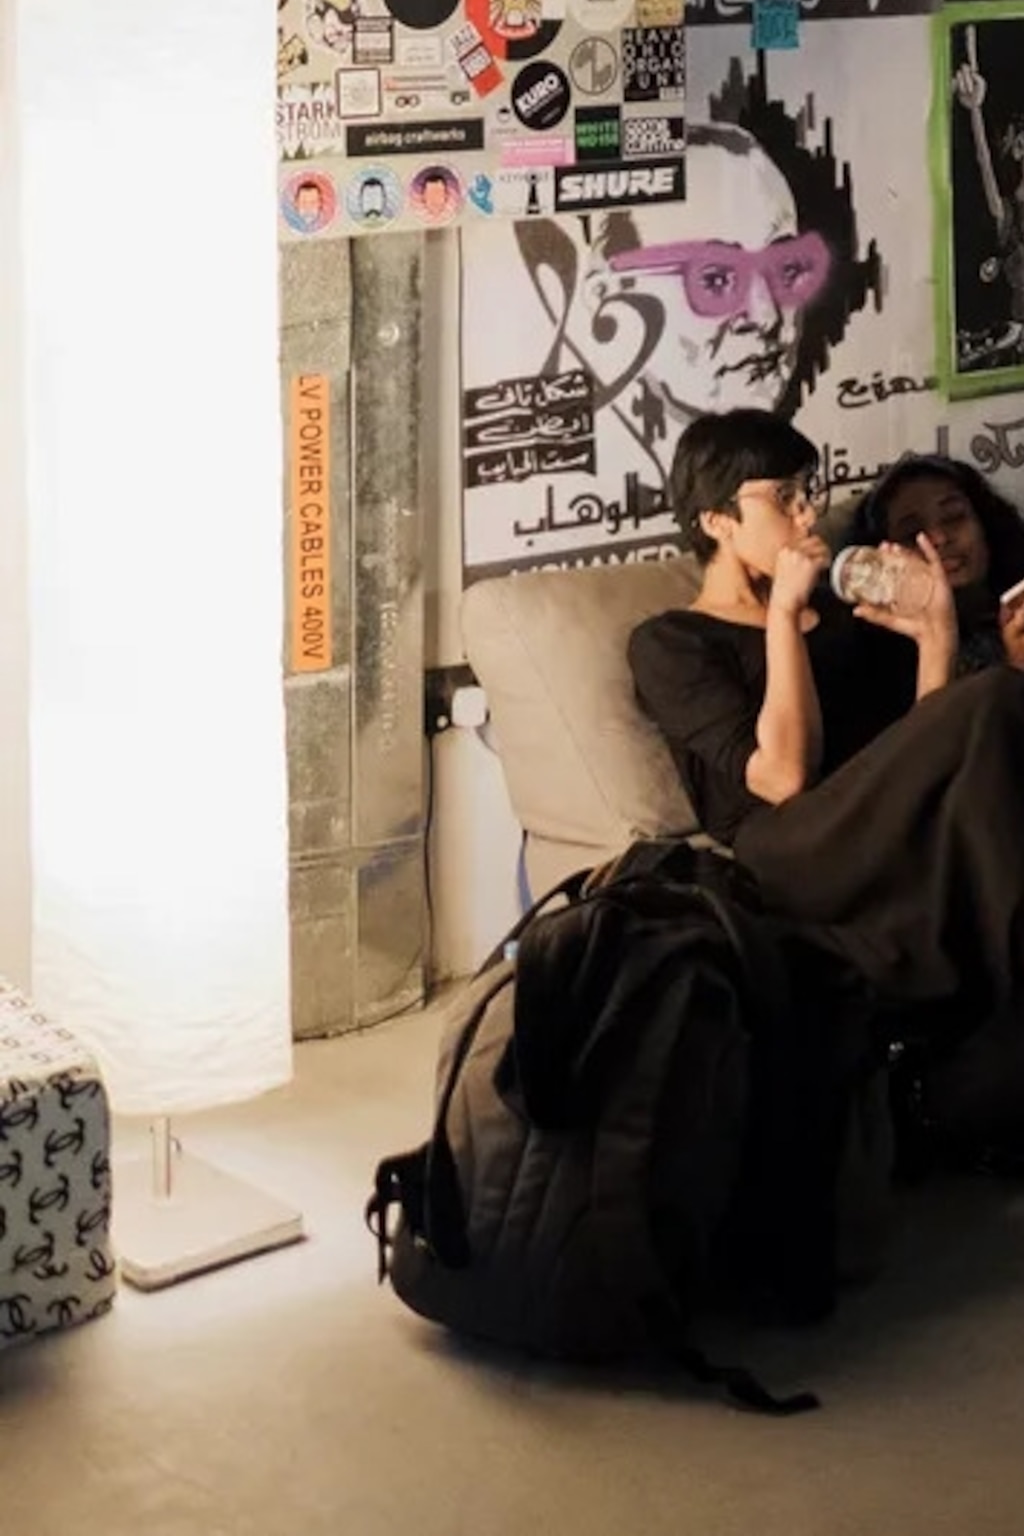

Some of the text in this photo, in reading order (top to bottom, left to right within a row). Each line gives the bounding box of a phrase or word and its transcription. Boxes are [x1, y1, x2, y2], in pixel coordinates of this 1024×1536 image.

[558, 167, 676, 203] SHURE
[298, 407, 323, 496] POWER
[299, 505, 325, 601] CABLES
[301, 605, 325, 661] 400V
